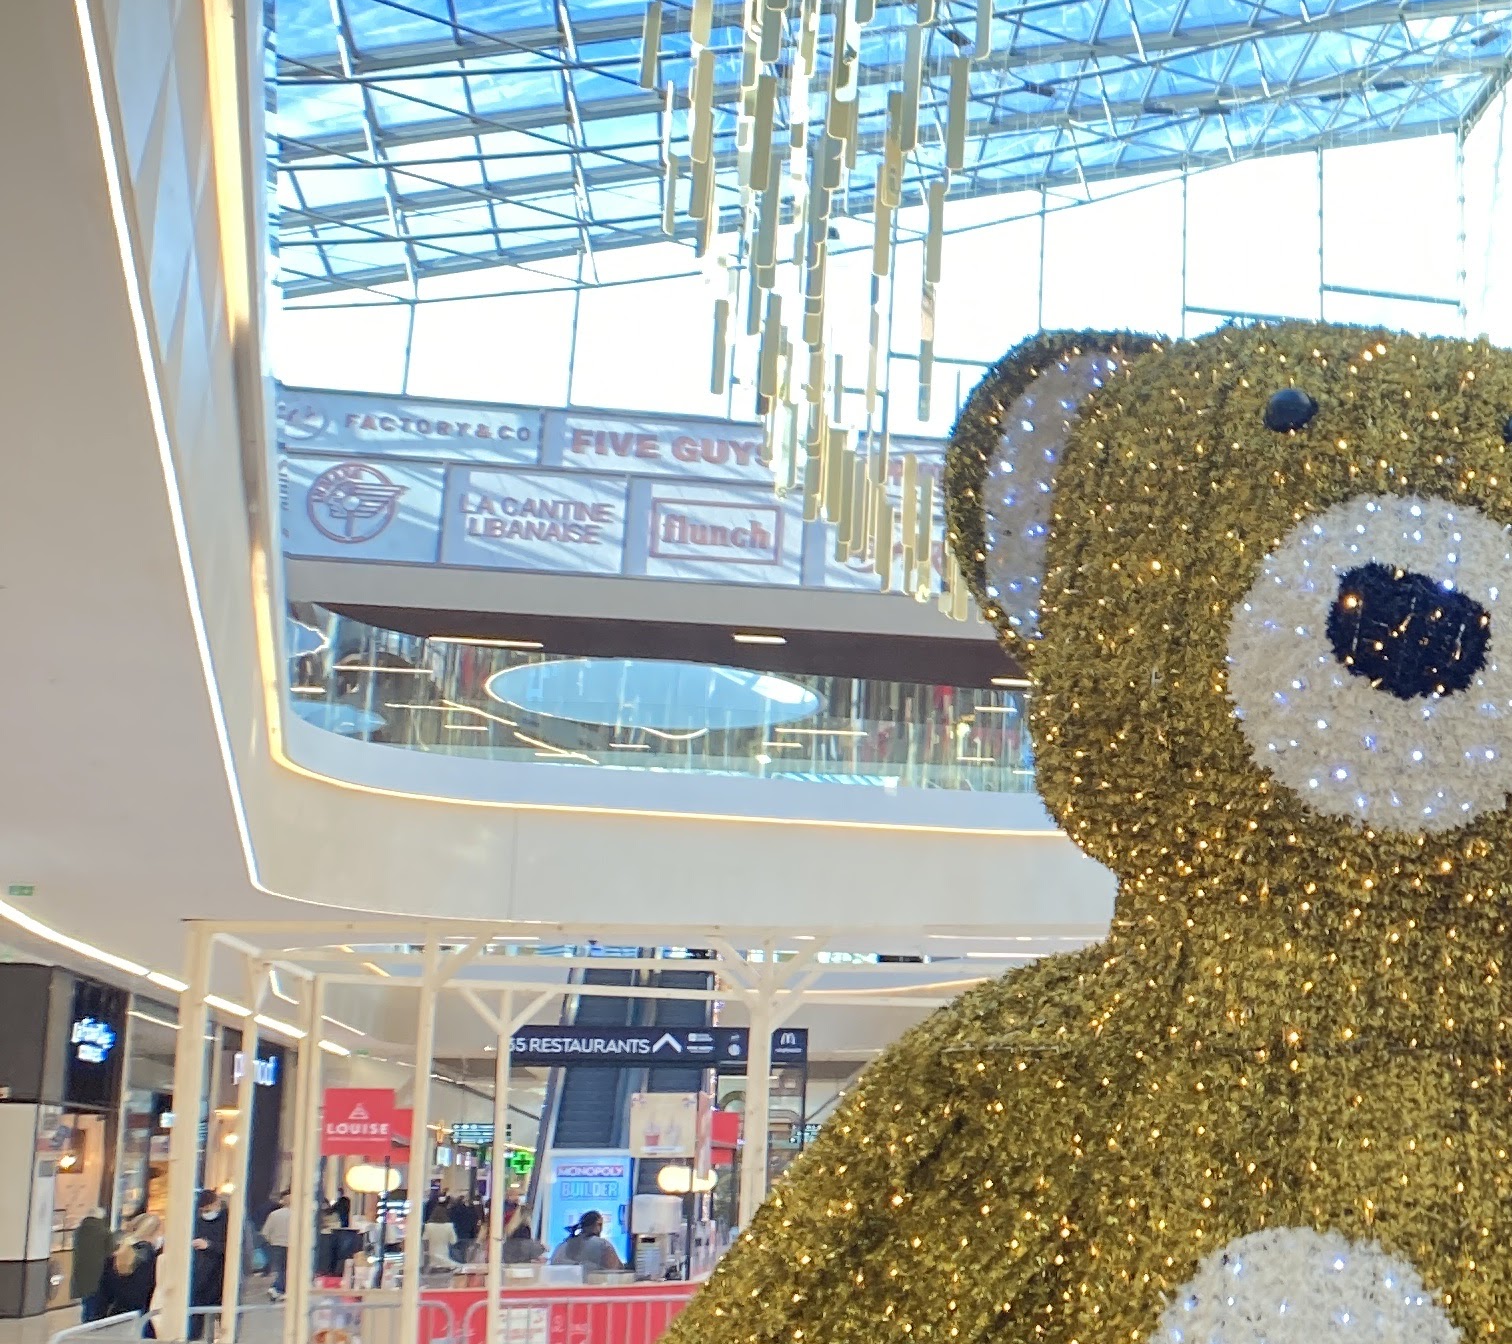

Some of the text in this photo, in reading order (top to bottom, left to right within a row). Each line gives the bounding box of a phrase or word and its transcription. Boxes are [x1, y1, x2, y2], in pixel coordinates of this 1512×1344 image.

[571, 428, 662, 458] FIVE
[458, 492, 615, 523] LA CANTINE
[661, 513, 772, 550] flunch
[529, 1037, 650, 1054] RESTAURANTS
[325, 1122, 391, 1136] LOUISE
[557, 1165, 623, 1177] MONOPOLY
[560, 1181, 619, 1198] BUILDER
